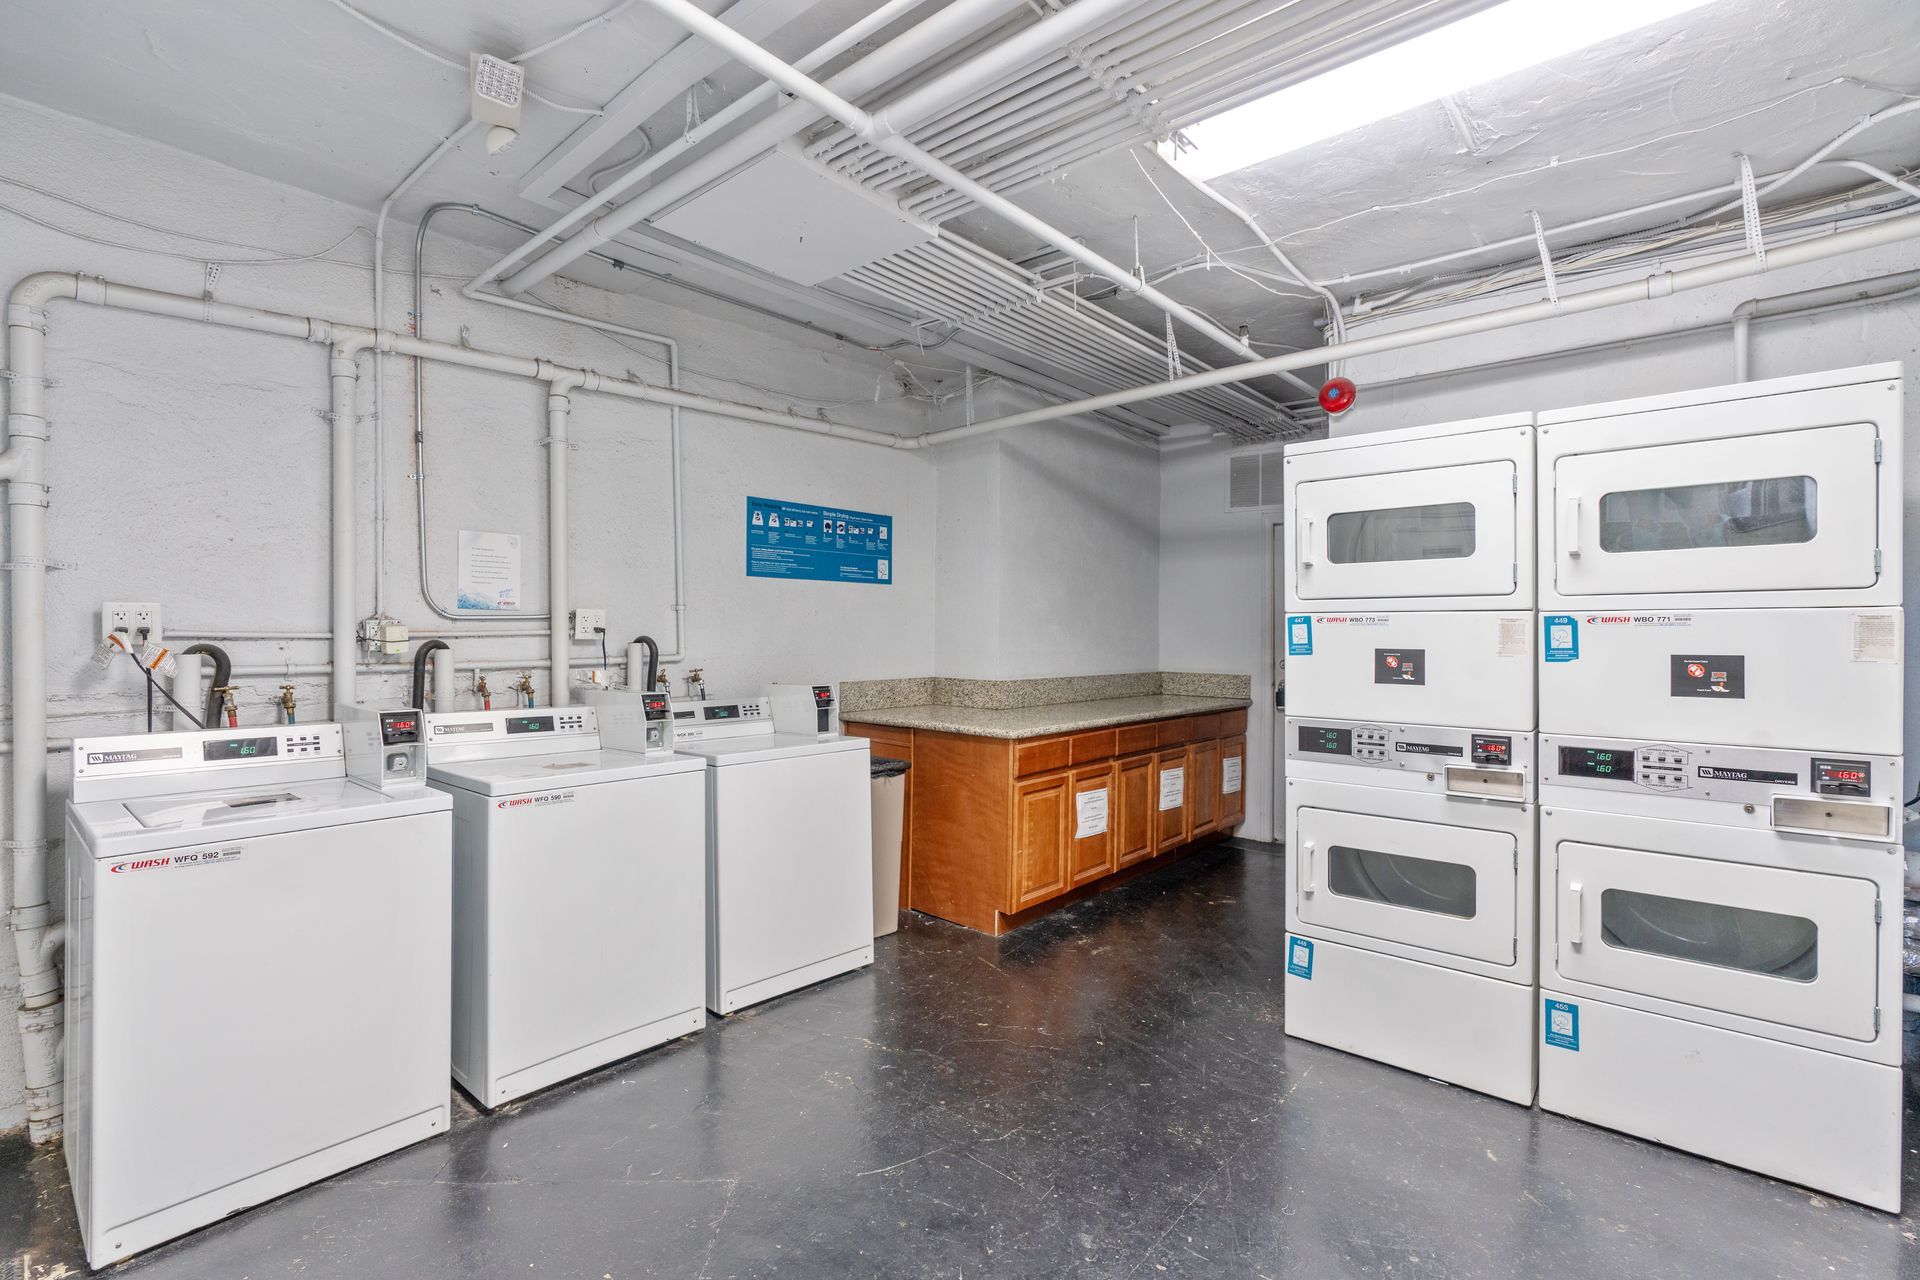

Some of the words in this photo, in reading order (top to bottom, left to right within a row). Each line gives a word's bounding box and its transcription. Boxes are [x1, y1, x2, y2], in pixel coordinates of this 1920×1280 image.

[103, 753, 137, 761] MAYTAG
[1713, 770, 1748, 779] MAYTAG
[509, 798, 533, 806] WASH
[131, 857, 170, 870] WASH
[174, 854, 198, 864] WFQ
[202, 851, 219, 860] 592
